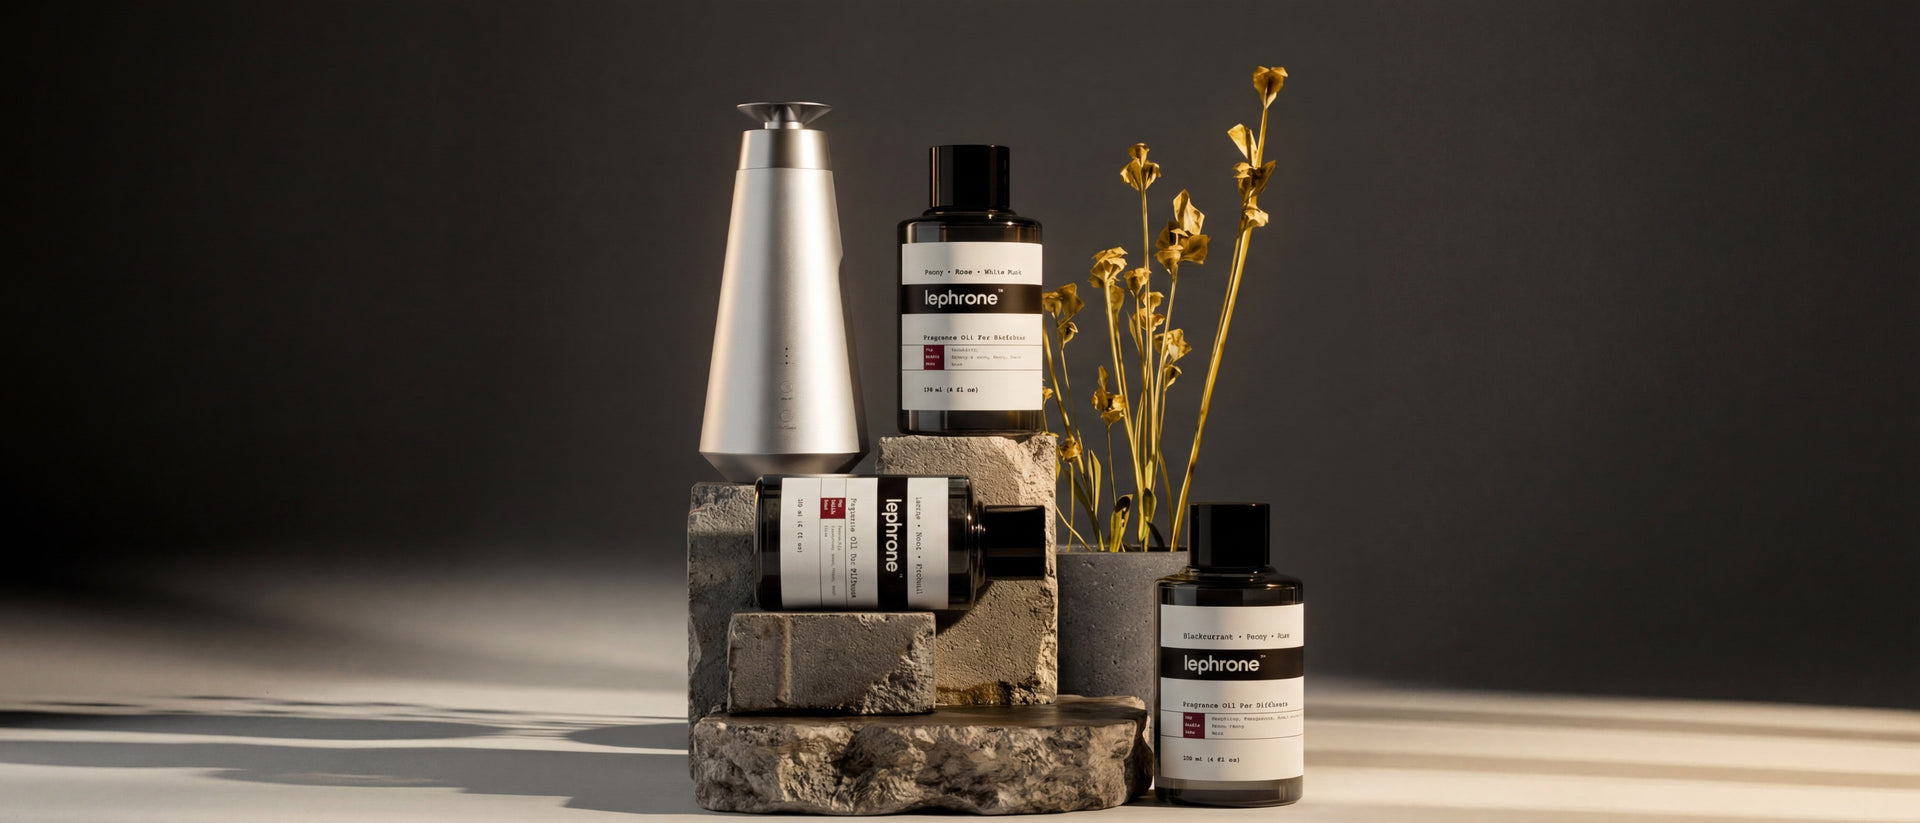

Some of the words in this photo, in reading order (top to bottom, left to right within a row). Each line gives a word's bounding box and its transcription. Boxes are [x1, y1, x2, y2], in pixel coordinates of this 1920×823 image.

[924, 289, 998, 309] lephrone
[881, 499, 902, 573] lephrone
[1183, 632, 1234, 641] Blackcurrant
[1184, 654, 1260, 675] lephrone
